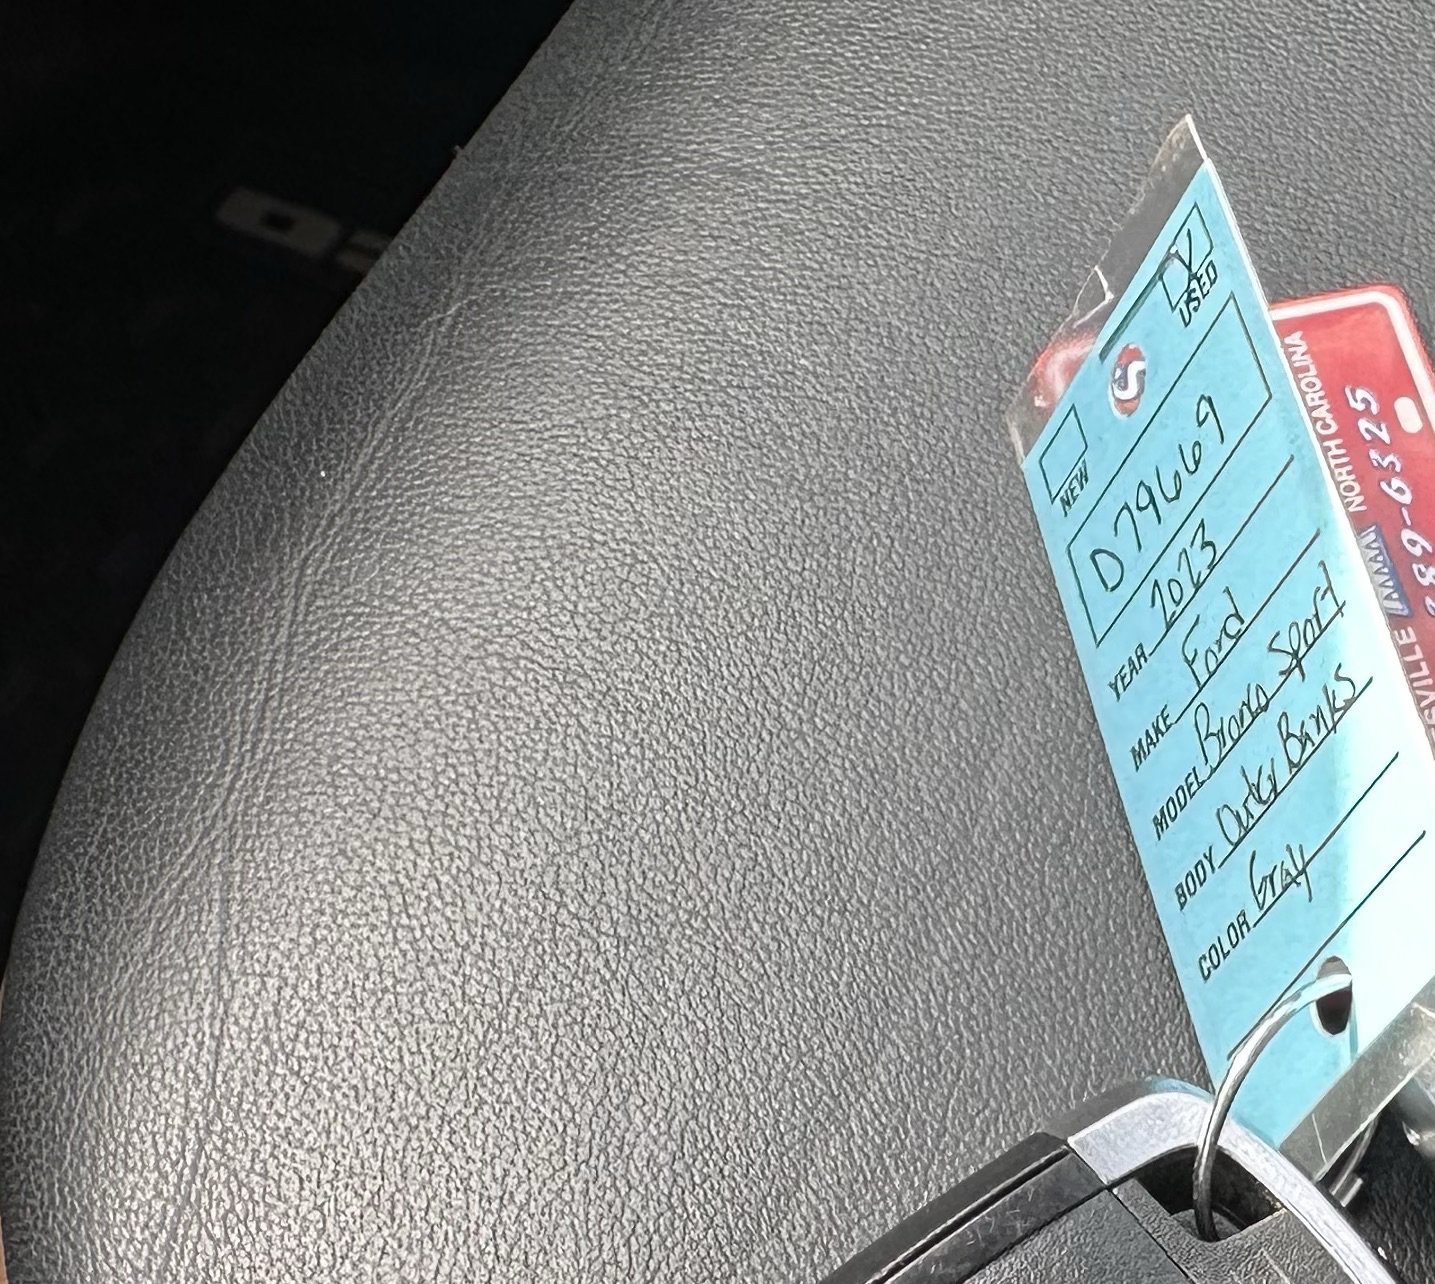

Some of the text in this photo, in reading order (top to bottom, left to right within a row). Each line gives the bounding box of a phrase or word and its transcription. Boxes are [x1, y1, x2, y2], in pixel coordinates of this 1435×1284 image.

[1178, 259, 1218, 328] USED
[1283, 329, 1340, 435] CAROLINA
[1059, 458, 1089, 518] NEW
[1090, 393, 1225, 593] D79669
[1319, 437, 1368, 513] NORTH
[1151, 517, 1217, 632] 2023
[1108, 641, 1148, 702] YEAR
[1181, 586, 1245, 690] Ford
[1194, 560, 1345, 773] Bronco Sport
[1130, 703, 1173, 773] MAKE
[1216, 662, 1357, 846] Outer Banks
[1152, 765, 1204, 841] MODEL
[1174, 844, 1216, 912] BODY
[1249, 843, 1314, 912] Gray
[1198, 908, 1251, 984] COLOR
